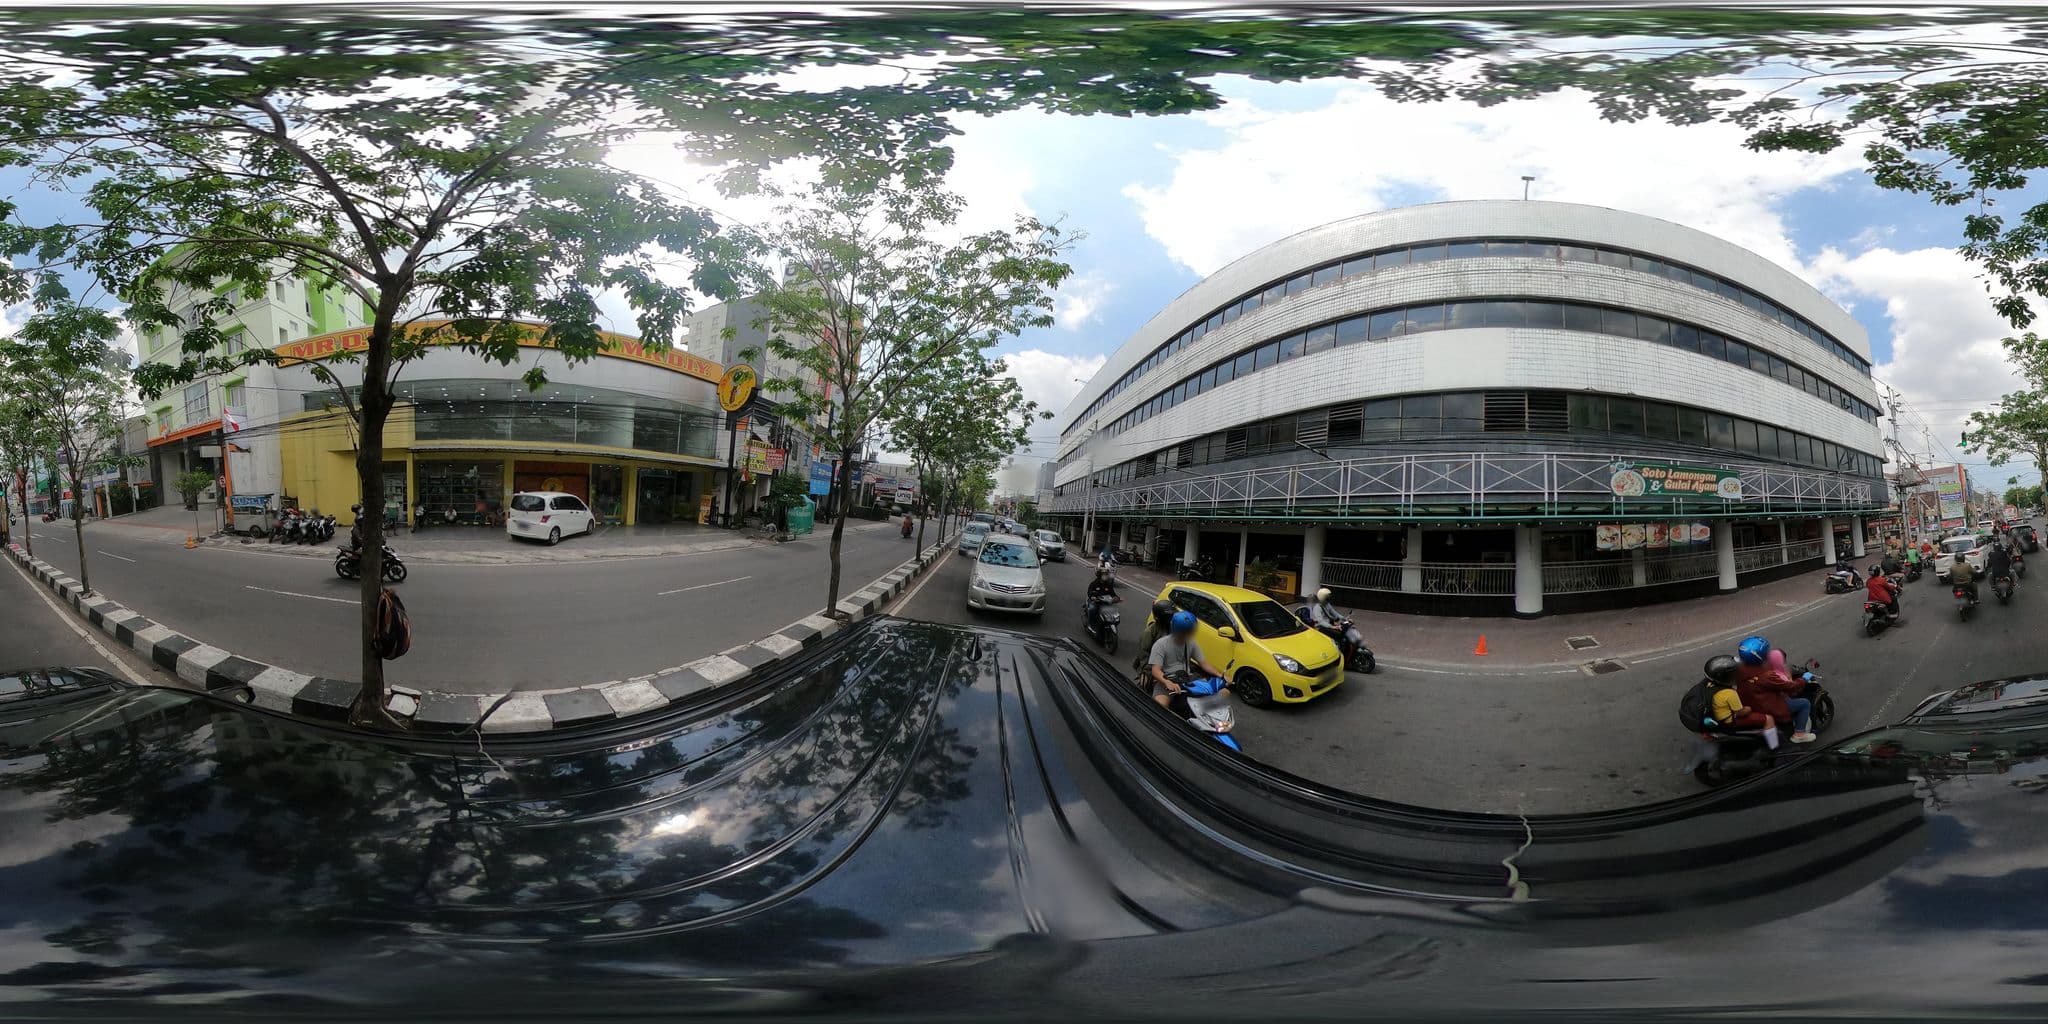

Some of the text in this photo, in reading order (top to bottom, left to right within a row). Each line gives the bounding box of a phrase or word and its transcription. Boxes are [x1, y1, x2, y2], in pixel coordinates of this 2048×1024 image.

[292, 338, 334, 357] MR
[1641, 467, 1717, 482] Soto Lamongan
[1651, 480, 1718, 493] & Gulai Ayam
